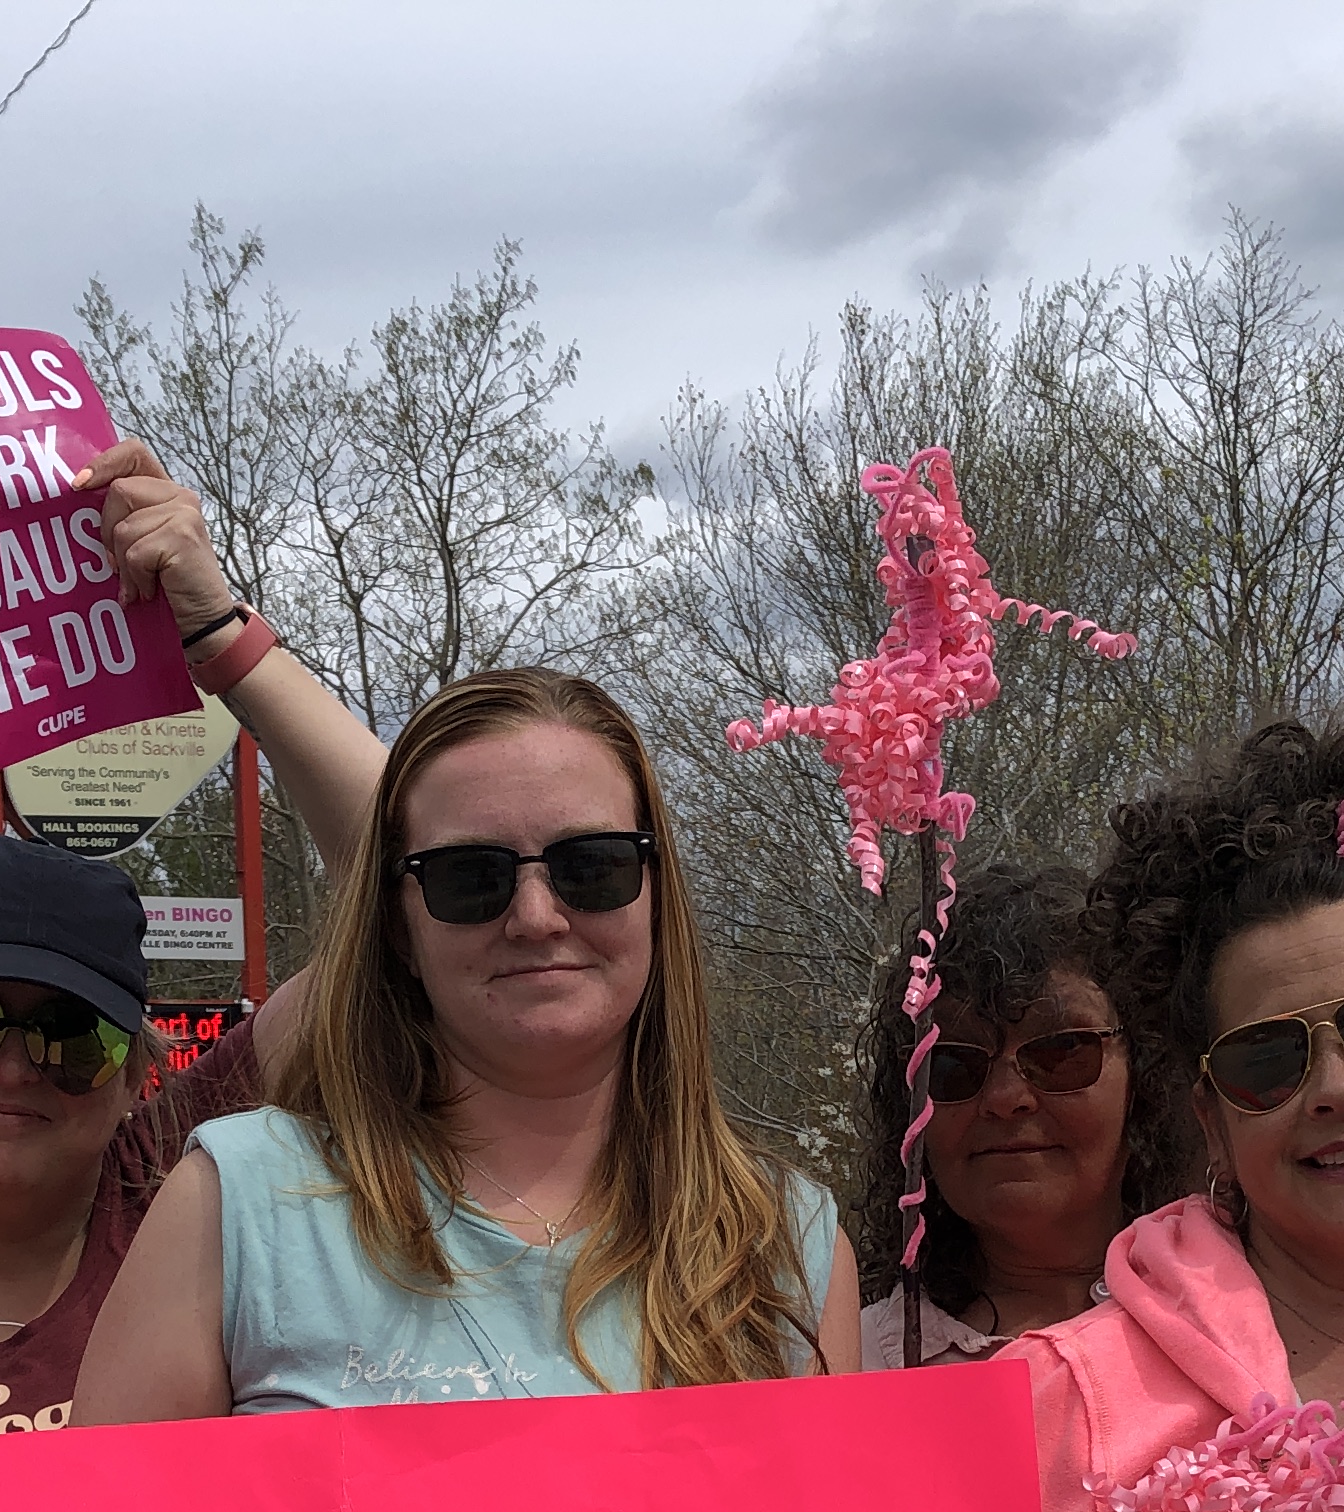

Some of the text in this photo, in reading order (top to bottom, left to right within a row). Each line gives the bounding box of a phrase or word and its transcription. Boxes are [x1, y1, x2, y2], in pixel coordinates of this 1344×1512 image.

[47, 598, 137, 689] DO
[37, 705, 87, 737] CUPE
[156, 722, 206, 738] Kinette
[76, 739, 205, 757] Clubs of Sackville
[78, 767, 96, 778] the
[99, 767, 170, 781] Community's
[61, 781, 110, 793] Greatest
[74, 798, 132, 807] SINCE 1961
[42, 822, 140, 833] HALL BOOKINGS
[66, 837, 119, 848] 865-0667
[144, 907, 233, 923] en BINGO
[215, 930, 227, 938] AT
[163, 940, 194, 949] BINGO
[196, 941, 234, 950] CENTRE
[196, 1013, 223, 1040] of
[339, 1344, 497, 1391] Believe
